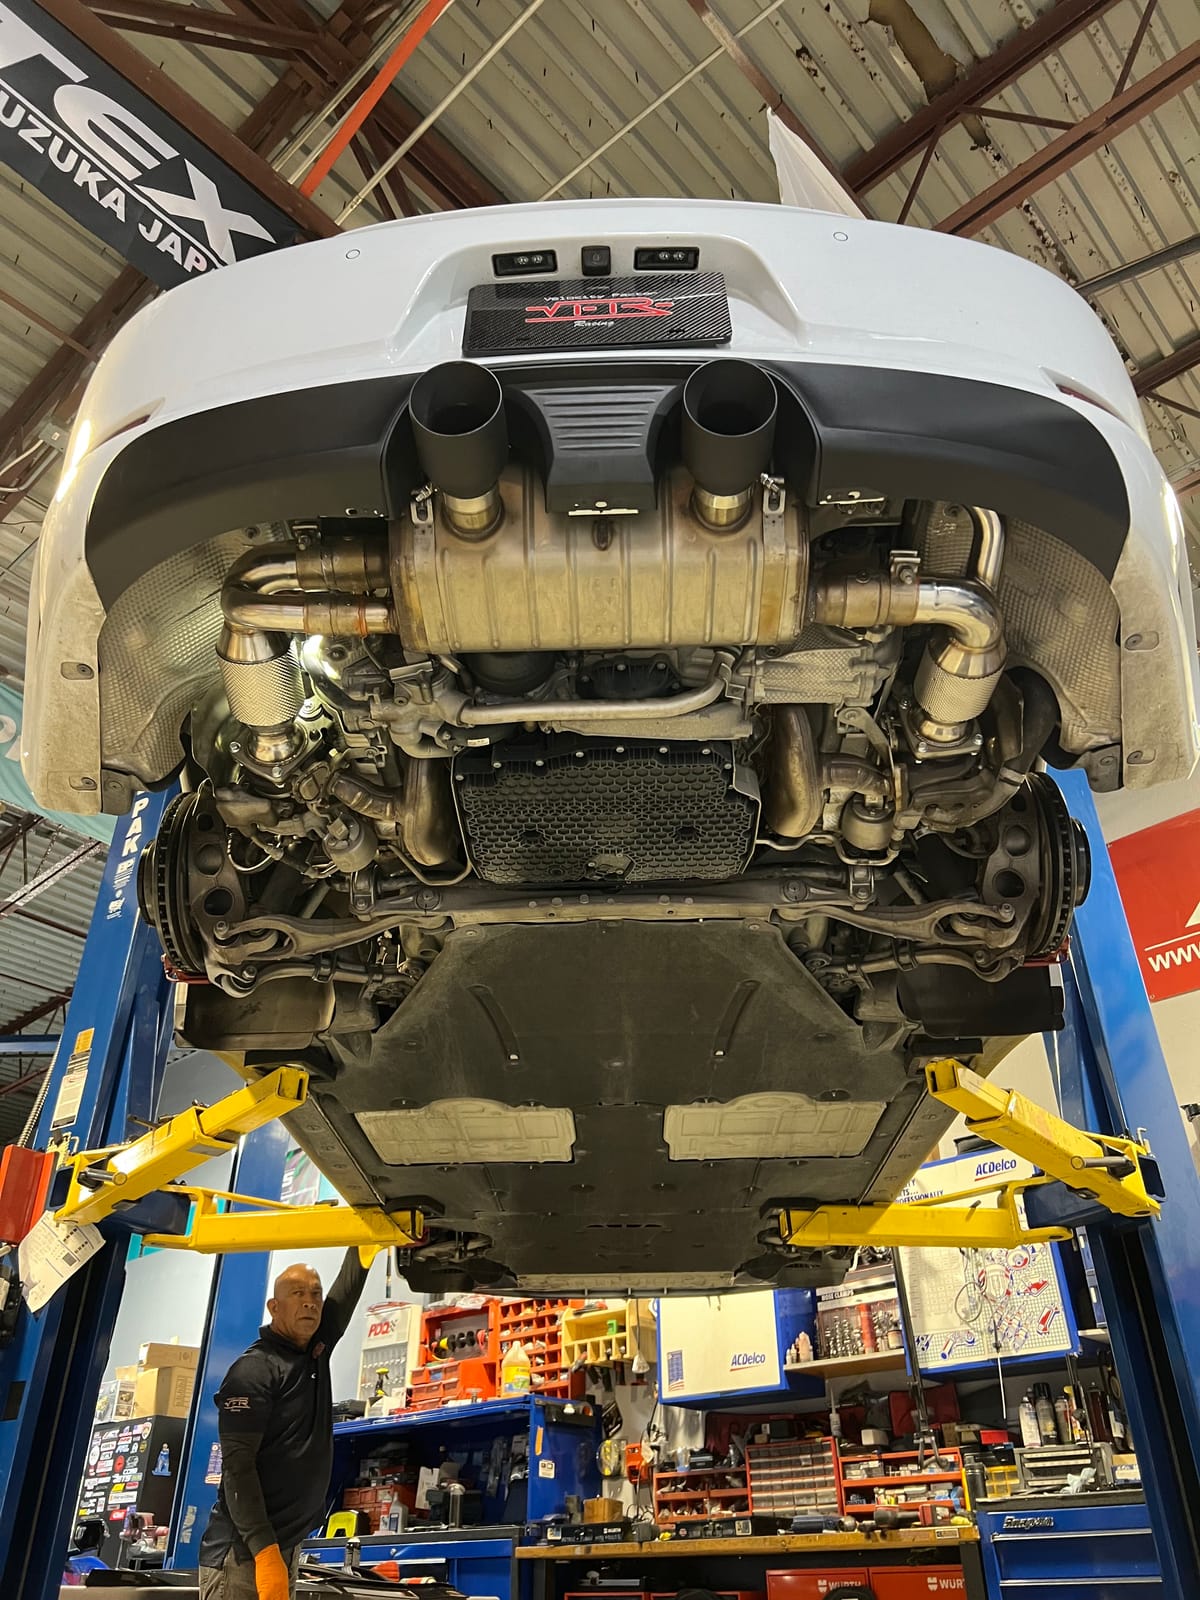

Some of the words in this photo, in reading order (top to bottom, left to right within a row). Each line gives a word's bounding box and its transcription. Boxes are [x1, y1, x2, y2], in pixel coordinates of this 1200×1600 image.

[138, 218, 214, 272] JAP
[975, 1159, 1017, 1177] ACDelco
[730, 1352, 766, 1367] ACDelco
